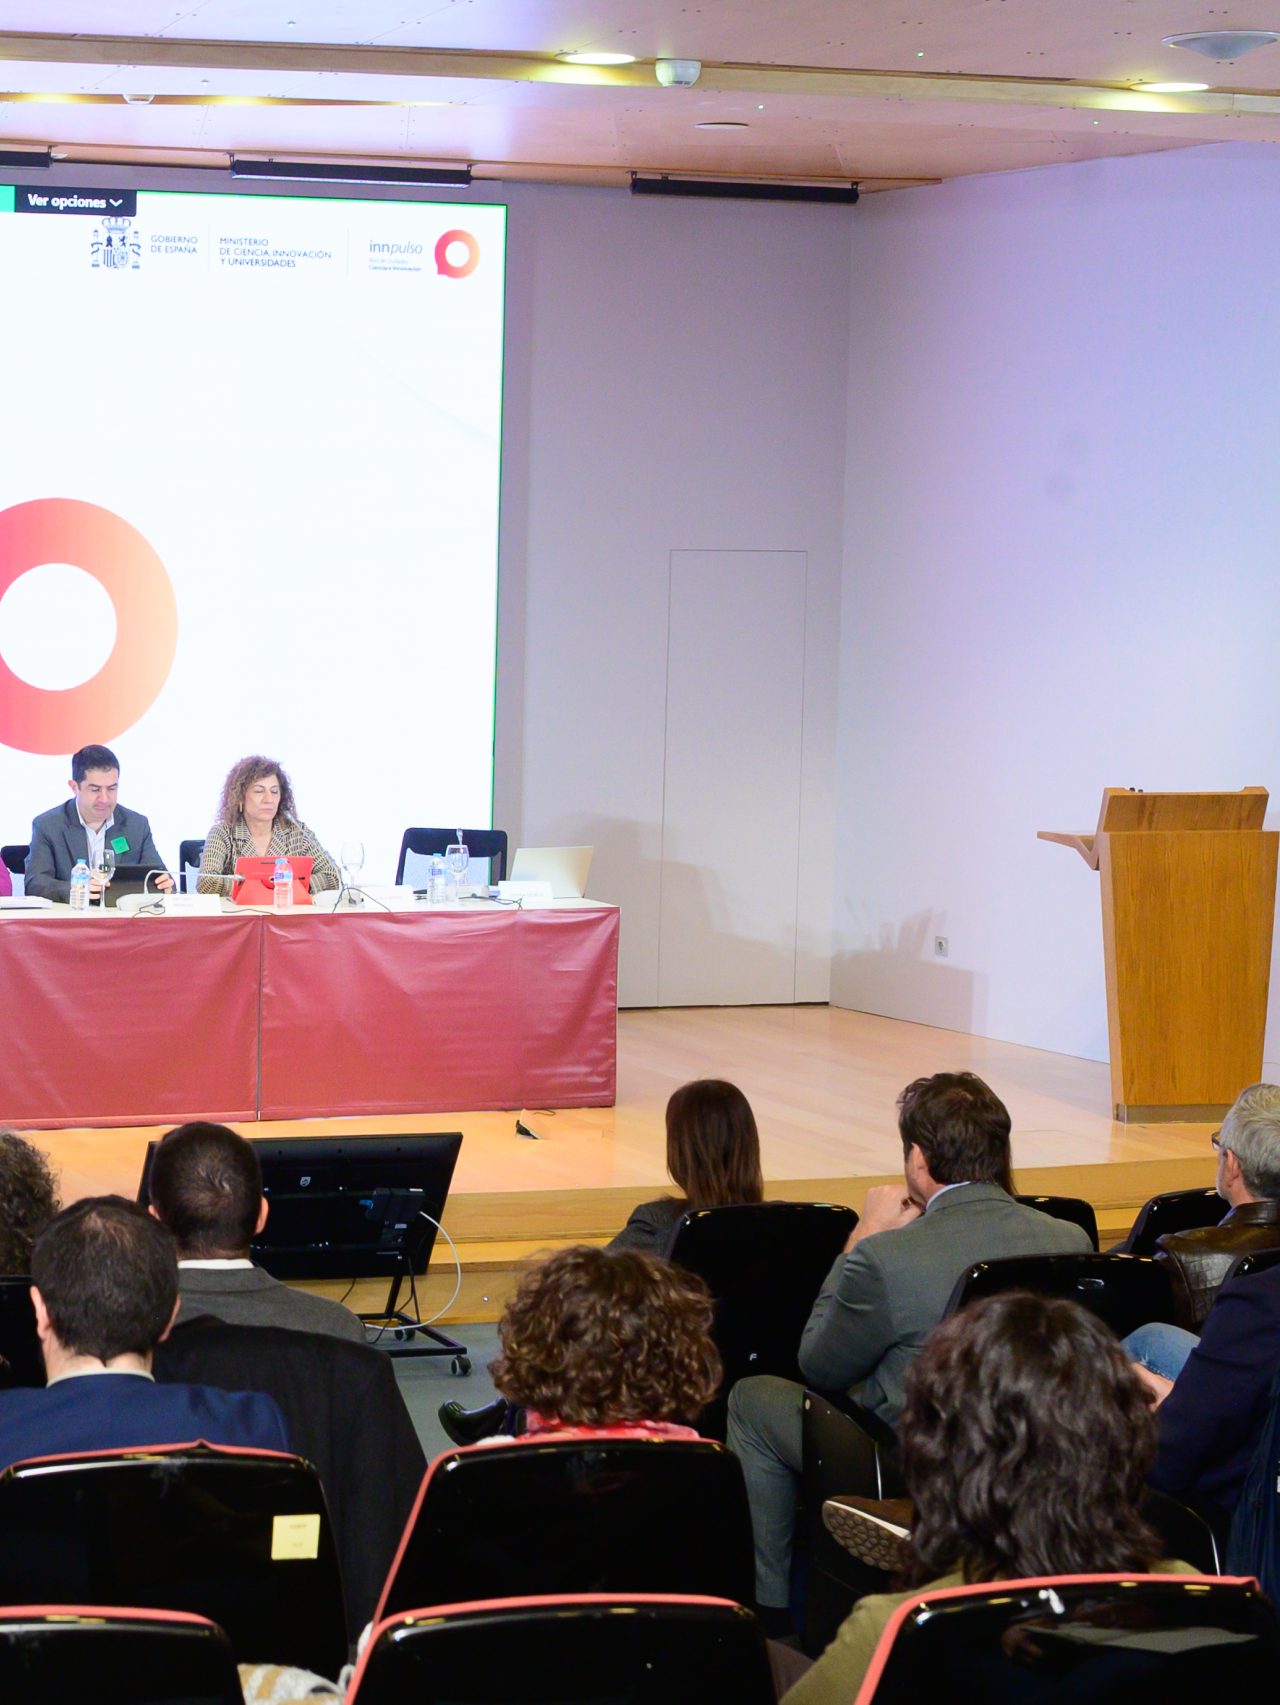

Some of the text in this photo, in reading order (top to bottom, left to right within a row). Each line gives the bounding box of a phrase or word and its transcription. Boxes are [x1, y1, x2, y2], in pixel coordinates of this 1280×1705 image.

[28, 194, 106, 210] Ver opciones
[151, 235, 198, 243] GOBIERNO
[220, 238, 268, 246] MINISTERIO
[151, 245, 196, 253] DE ESPAÑA
[370, 240, 422, 255] innpulso
[273, 250, 331, 258] INNOVACIÓN
[220, 257, 295, 267] Y UNIVERSIDADES
